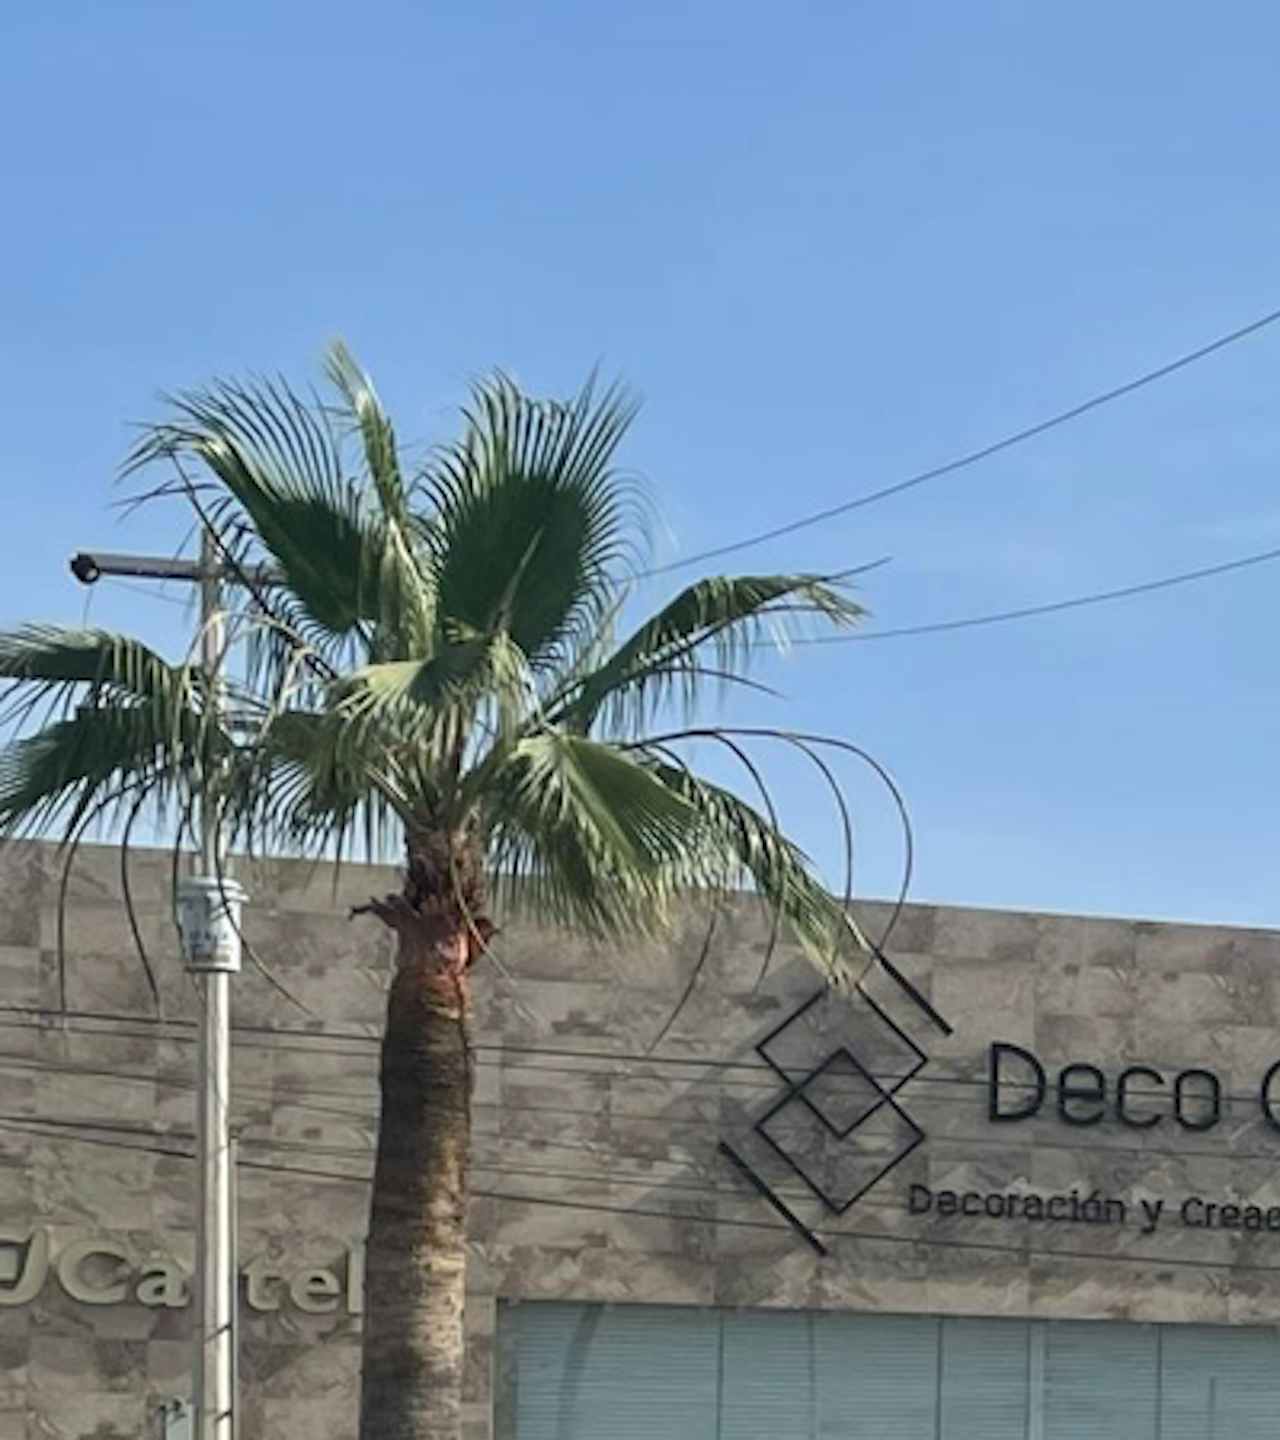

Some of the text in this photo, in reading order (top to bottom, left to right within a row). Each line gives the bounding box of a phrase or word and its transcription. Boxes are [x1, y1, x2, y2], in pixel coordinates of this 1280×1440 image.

[988, 1042, 1220, 1132] Deco
[908, 1183, 1127, 1224] Decoración
[1140, 1198, 1164, 1234] y
[57, 1239, 363, 1313] Catel
